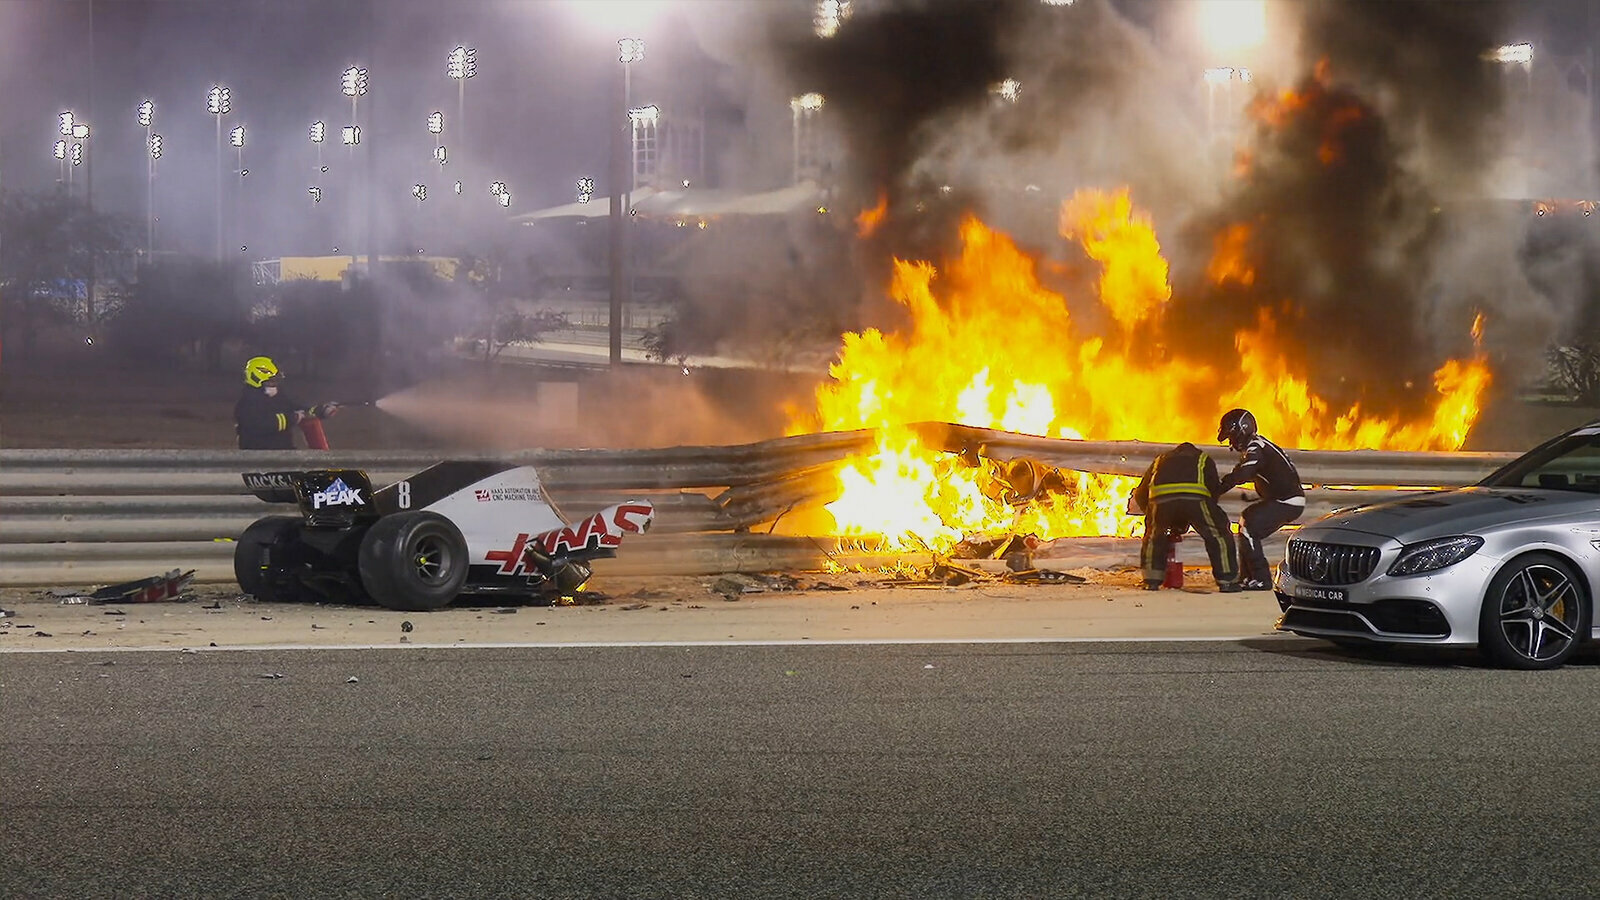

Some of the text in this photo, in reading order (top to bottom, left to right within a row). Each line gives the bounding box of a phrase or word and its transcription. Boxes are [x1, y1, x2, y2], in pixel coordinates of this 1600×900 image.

[313, 488, 365, 509] PEAK
[398, 480, 411, 509] 8
[1301, 587, 1327, 599] MEDICAL
[1328, 591, 1344, 601] CAR
